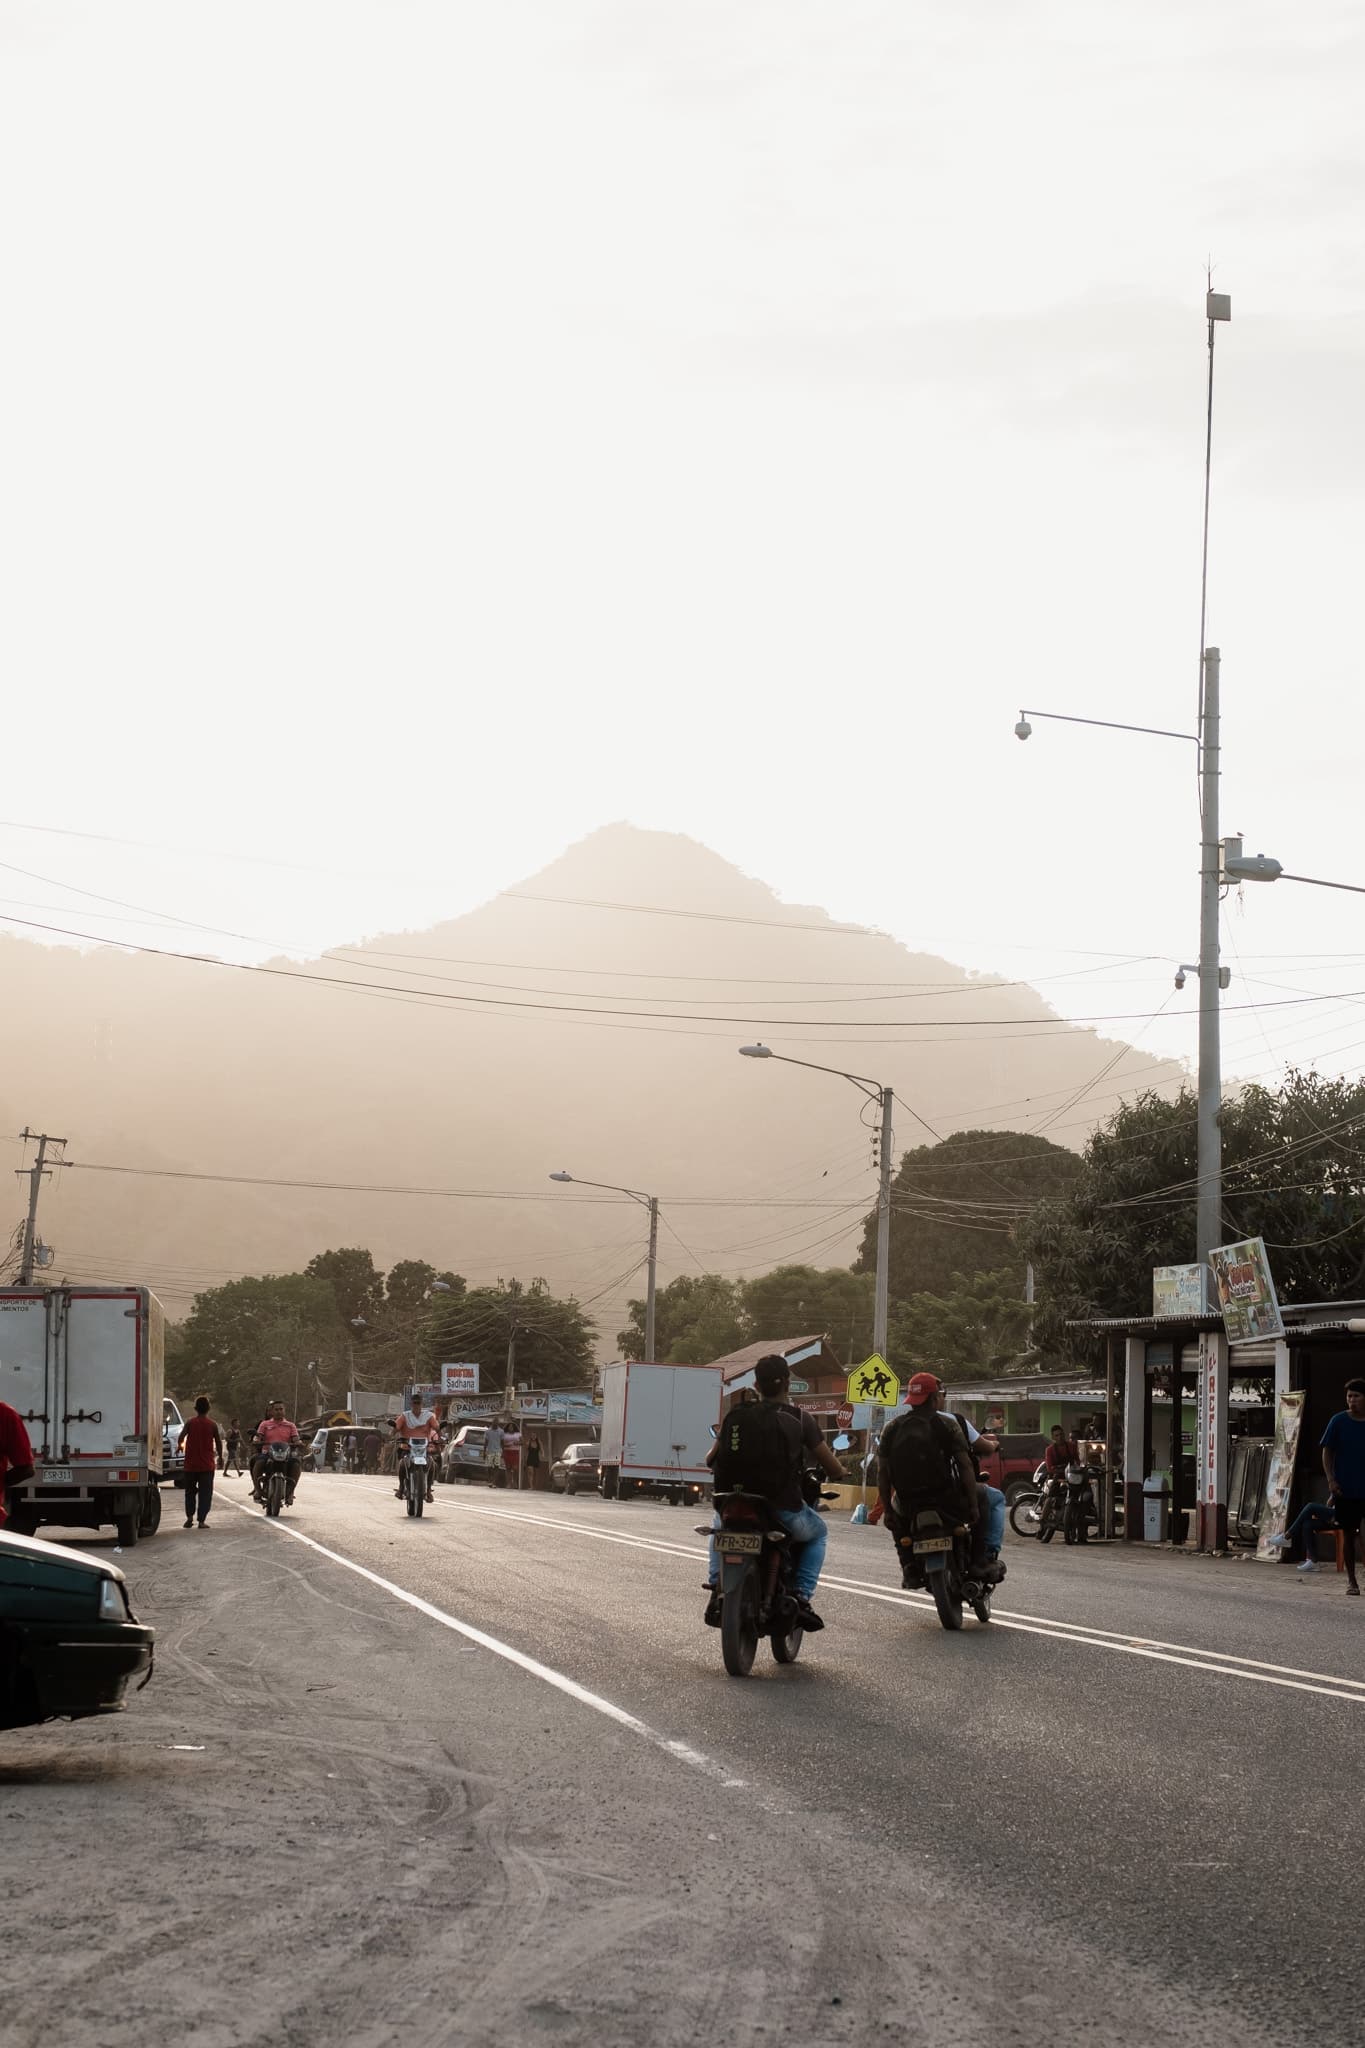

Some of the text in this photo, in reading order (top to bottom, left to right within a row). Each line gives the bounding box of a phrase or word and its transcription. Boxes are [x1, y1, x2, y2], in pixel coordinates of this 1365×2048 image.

[446, 1378, 475, 1389] Sadhana
[798, 1401, 817, 1410] Claro
[839, 1410, 853, 1420] STOP
[1208, 1375, 1216, 1500] REFUGIO
